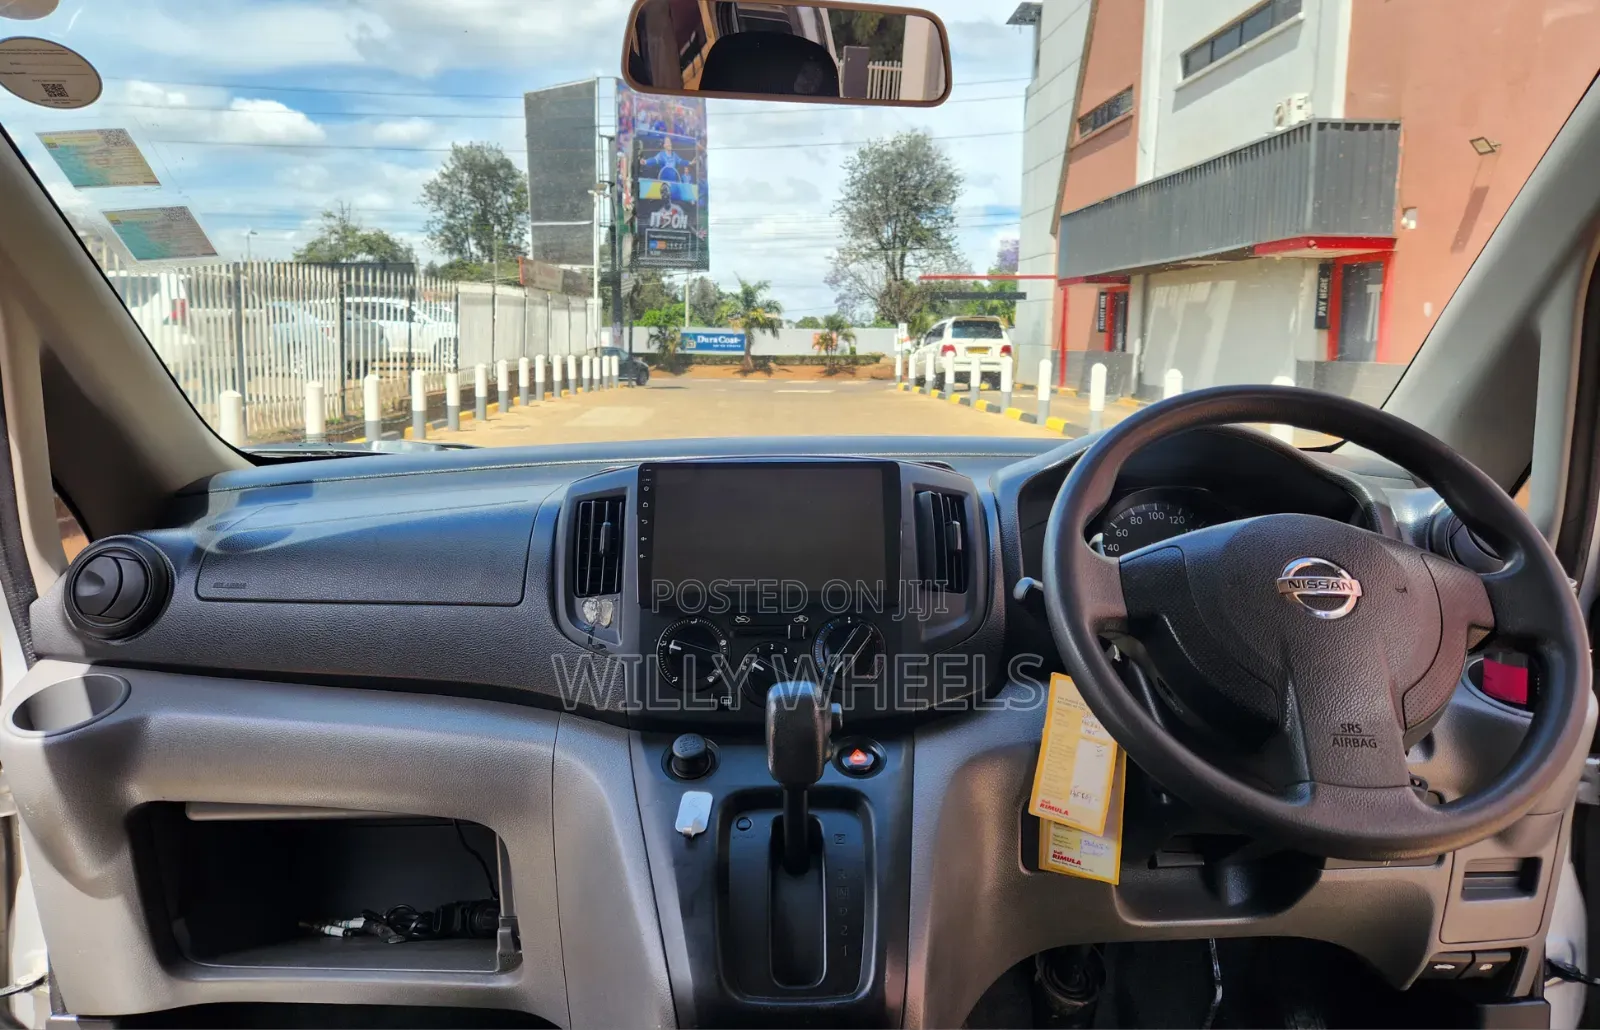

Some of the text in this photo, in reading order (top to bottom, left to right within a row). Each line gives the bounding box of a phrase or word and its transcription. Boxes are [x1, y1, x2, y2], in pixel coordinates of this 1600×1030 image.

[1318, 300, 1327, 316] PAY
[1130, 516, 1143, 525] 80
[1148, 511, 1164, 520] 100
[1169, 516, 1185, 525] 120
[1115, 528, 1129, 537] 60
[1107, 543, 1120, 552] 40
[1288, 580, 1353, 591] NISSAN
[1340, 723, 1362, 733] SRS
[1332, 737, 1377, 748] AIRBAG
[1040, 802, 1069, 816] RIMULA
[1052, 853, 1081, 865] RIMULA
[840, 925, 848, 936] 2
